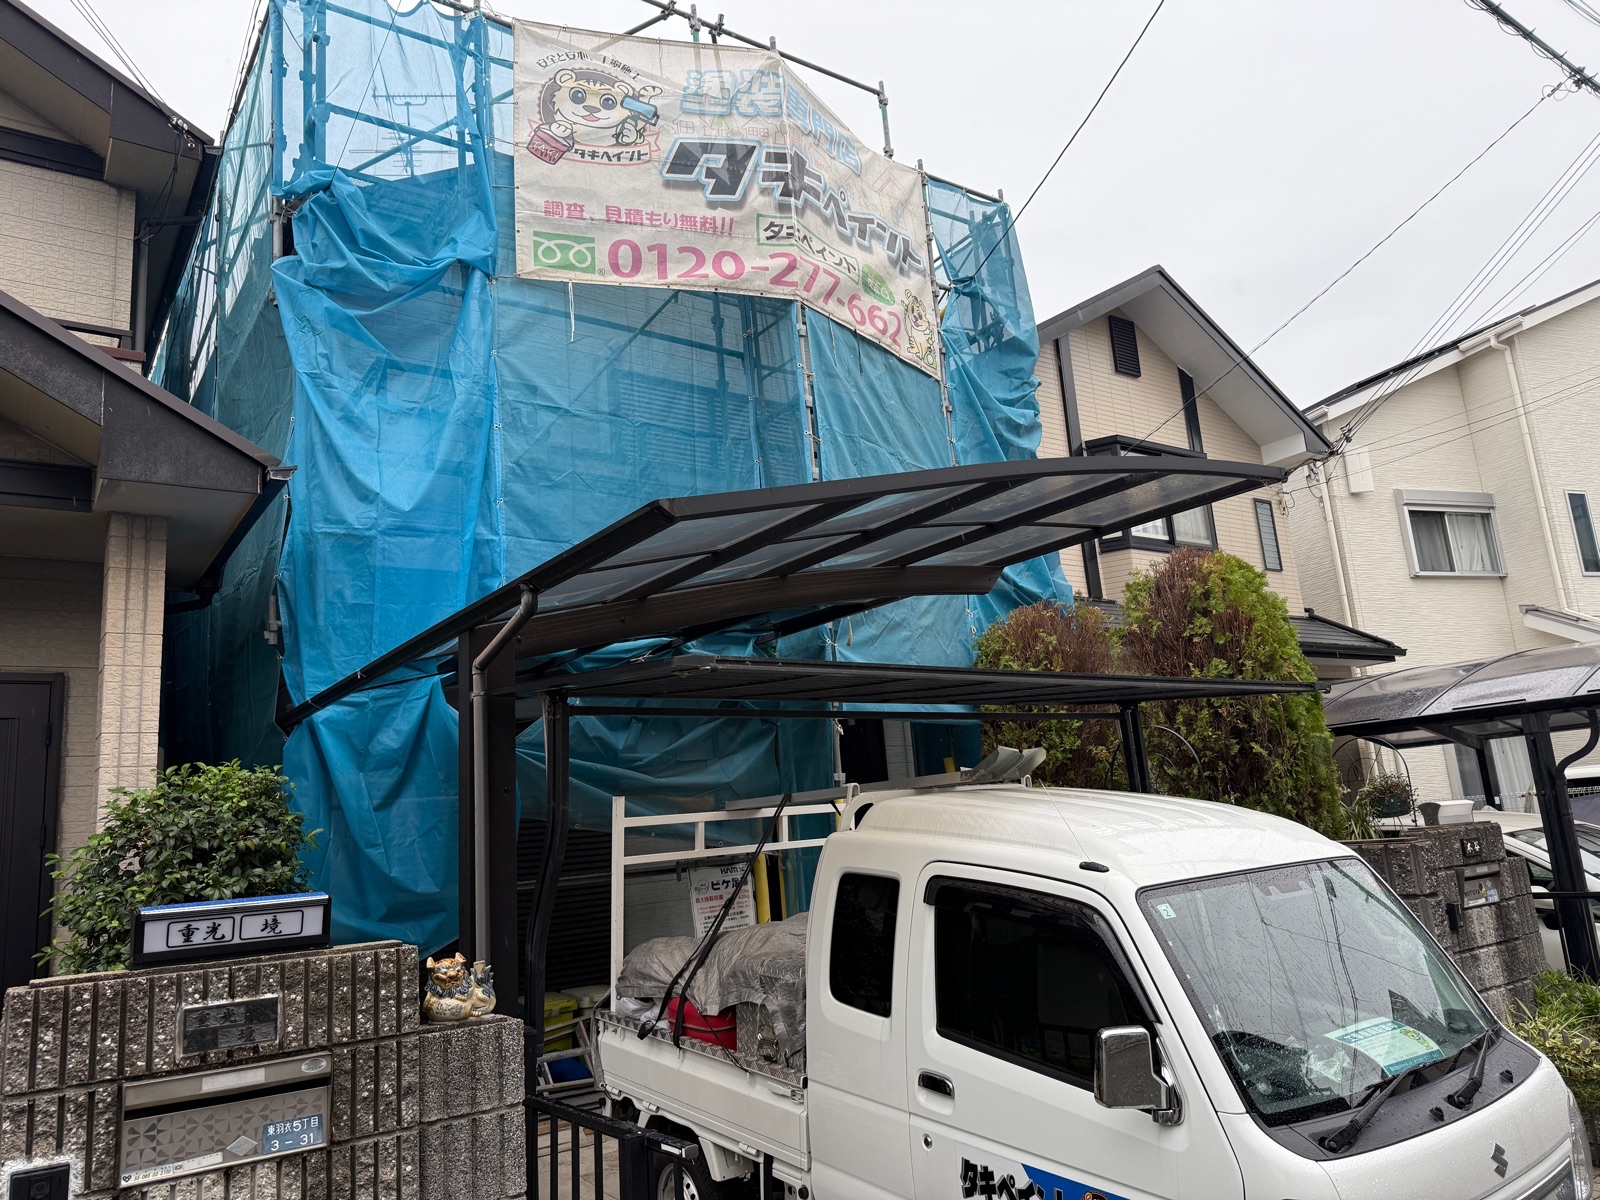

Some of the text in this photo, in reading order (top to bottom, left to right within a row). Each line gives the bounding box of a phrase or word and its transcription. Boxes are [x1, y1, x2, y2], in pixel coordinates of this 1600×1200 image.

[659, 137, 927, 272] タキペイント
[763, 221, 857, 274] タキペイント
[607, 238, 902, 349] 0120-277-662
[178, 915, 283, 944] 重光 境
[267, 1116, 319, 1136] 東羽衣5丁目
[960, 1157, 1063, 1200] タキペイ
